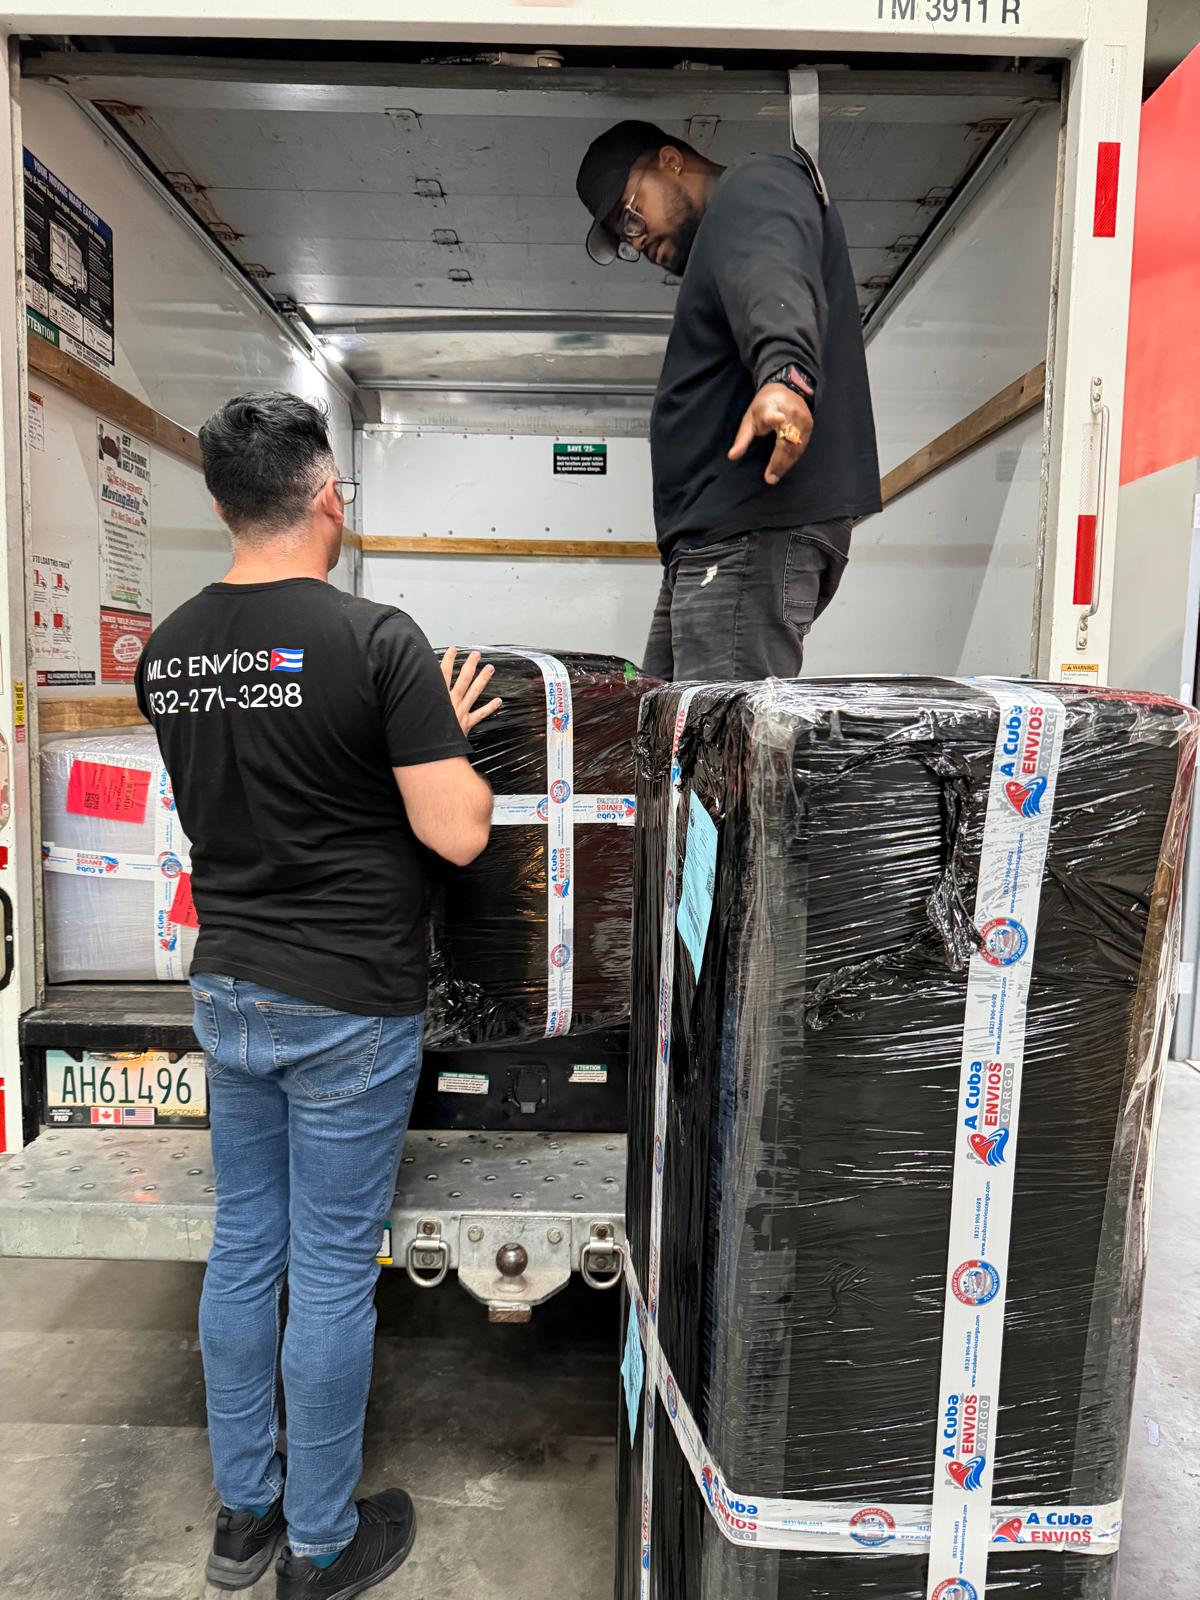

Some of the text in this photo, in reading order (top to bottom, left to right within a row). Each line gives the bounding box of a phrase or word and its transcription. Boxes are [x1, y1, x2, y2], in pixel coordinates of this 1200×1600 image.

[926, 0, 987, 23] 3911
[1002, 0, 1020, 24] R
[27, 314, 55, 342] TTENTION
[147, 649, 269, 681] MLC ENVÍOS
[1000, 706, 1023, 777] A Cuba
[1022, 707, 1043, 774] ENVIOS
[62, 1066, 192, 1104] AH61496
[964, 1061, 982, 1130] A Cuba
[985, 1062, 1003, 1127] ENVIOS
[1001, 1067, 1013, 1122] CARGO
[943, 1394, 959, 1458] A Cuba
[962, 1395, 978, 1454] ENVIOS
[977, 1400, 990, 1451] CARGO
[713, 1474, 758, 1515] A Cuba
[714, 1492, 757, 1531] ENVIOS
[1026, 1512, 1093, 1525] A Cuba
[1031, 1530, 1091, 1544] ENVIOS
